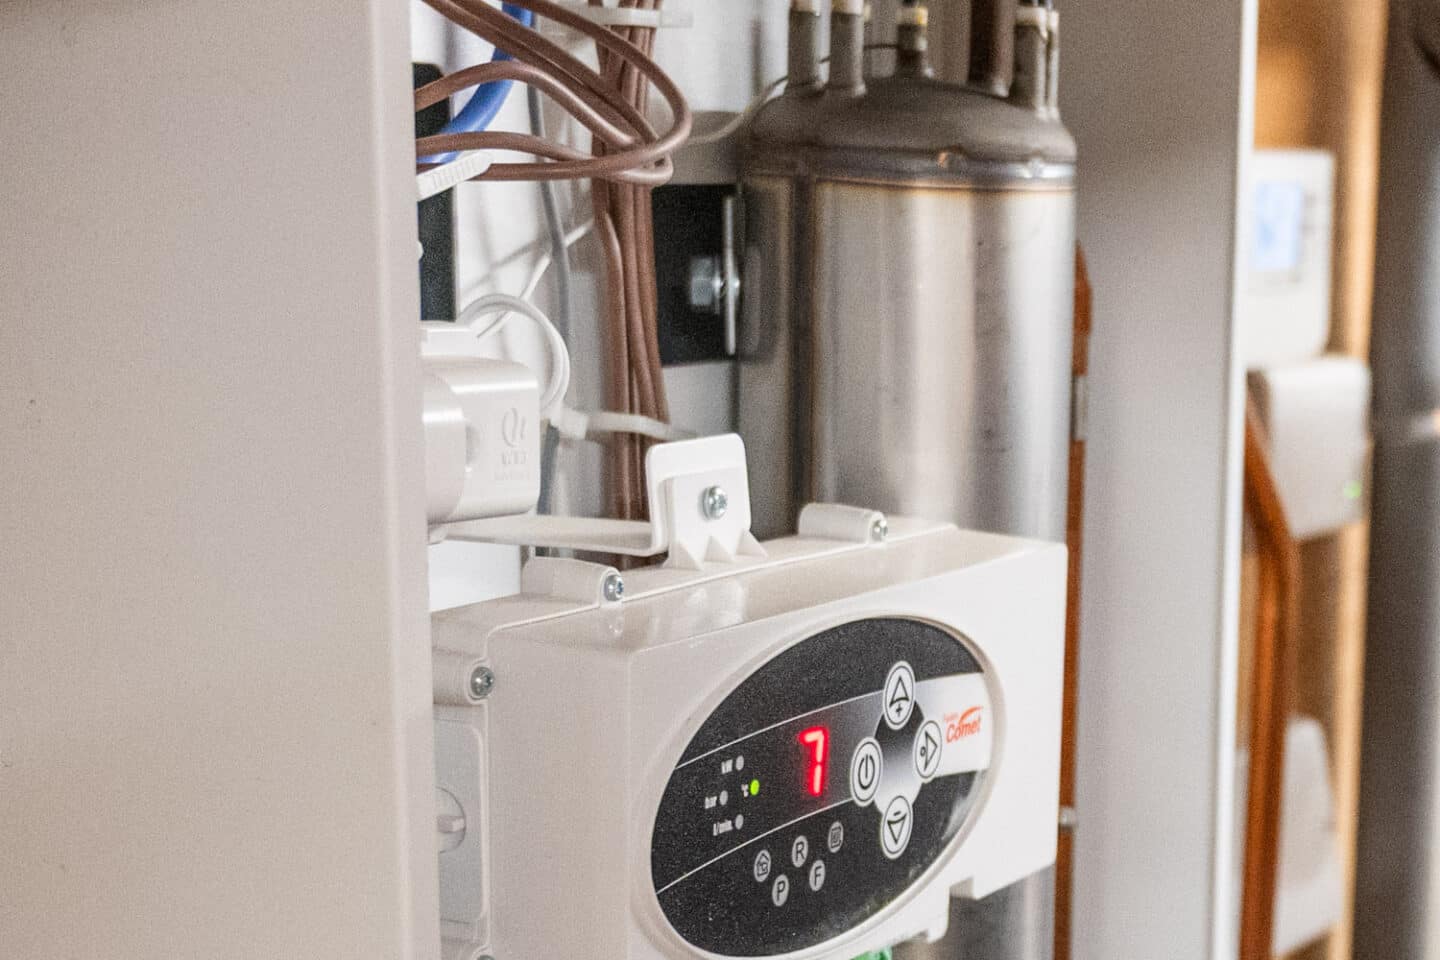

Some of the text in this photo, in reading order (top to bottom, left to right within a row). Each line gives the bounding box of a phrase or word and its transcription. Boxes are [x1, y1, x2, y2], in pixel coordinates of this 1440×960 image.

[946, 712, 982, 743] Comet
[802, 728, 826, 795] 7
[796, 841, 806, 861] R
[815, 865, 822, 887] F
[777, 880, 786, 901] P
